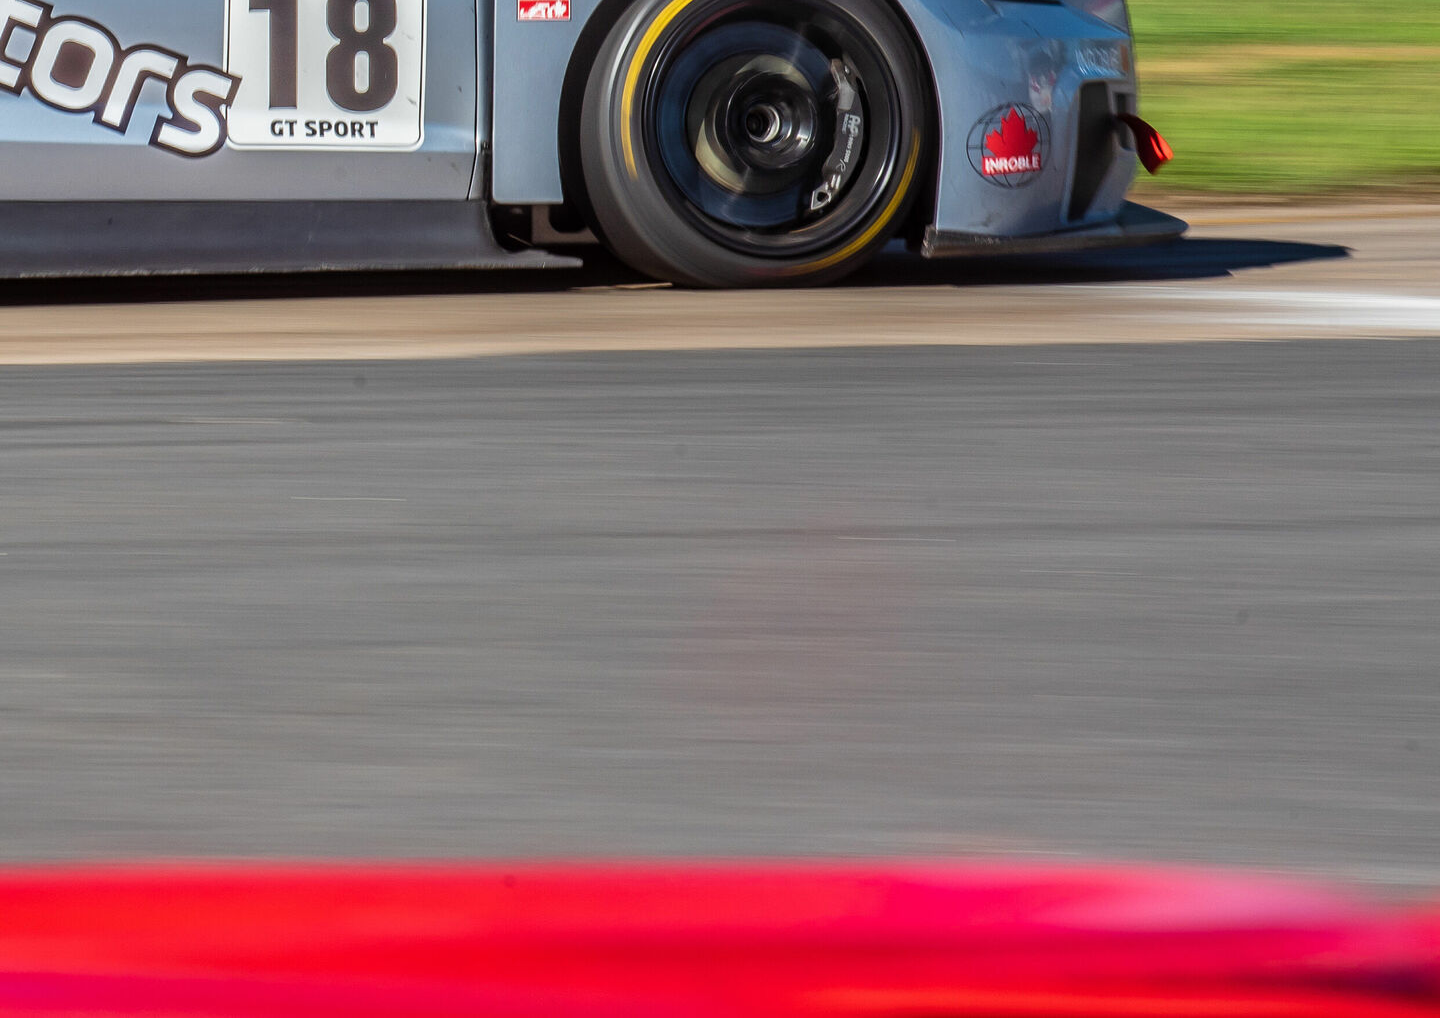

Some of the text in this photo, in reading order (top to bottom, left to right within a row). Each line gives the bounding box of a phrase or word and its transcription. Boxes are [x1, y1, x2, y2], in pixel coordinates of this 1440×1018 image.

[270, 120, 379, 138] GT SPORT
[984, 155, 1039, 173] INROBLE
